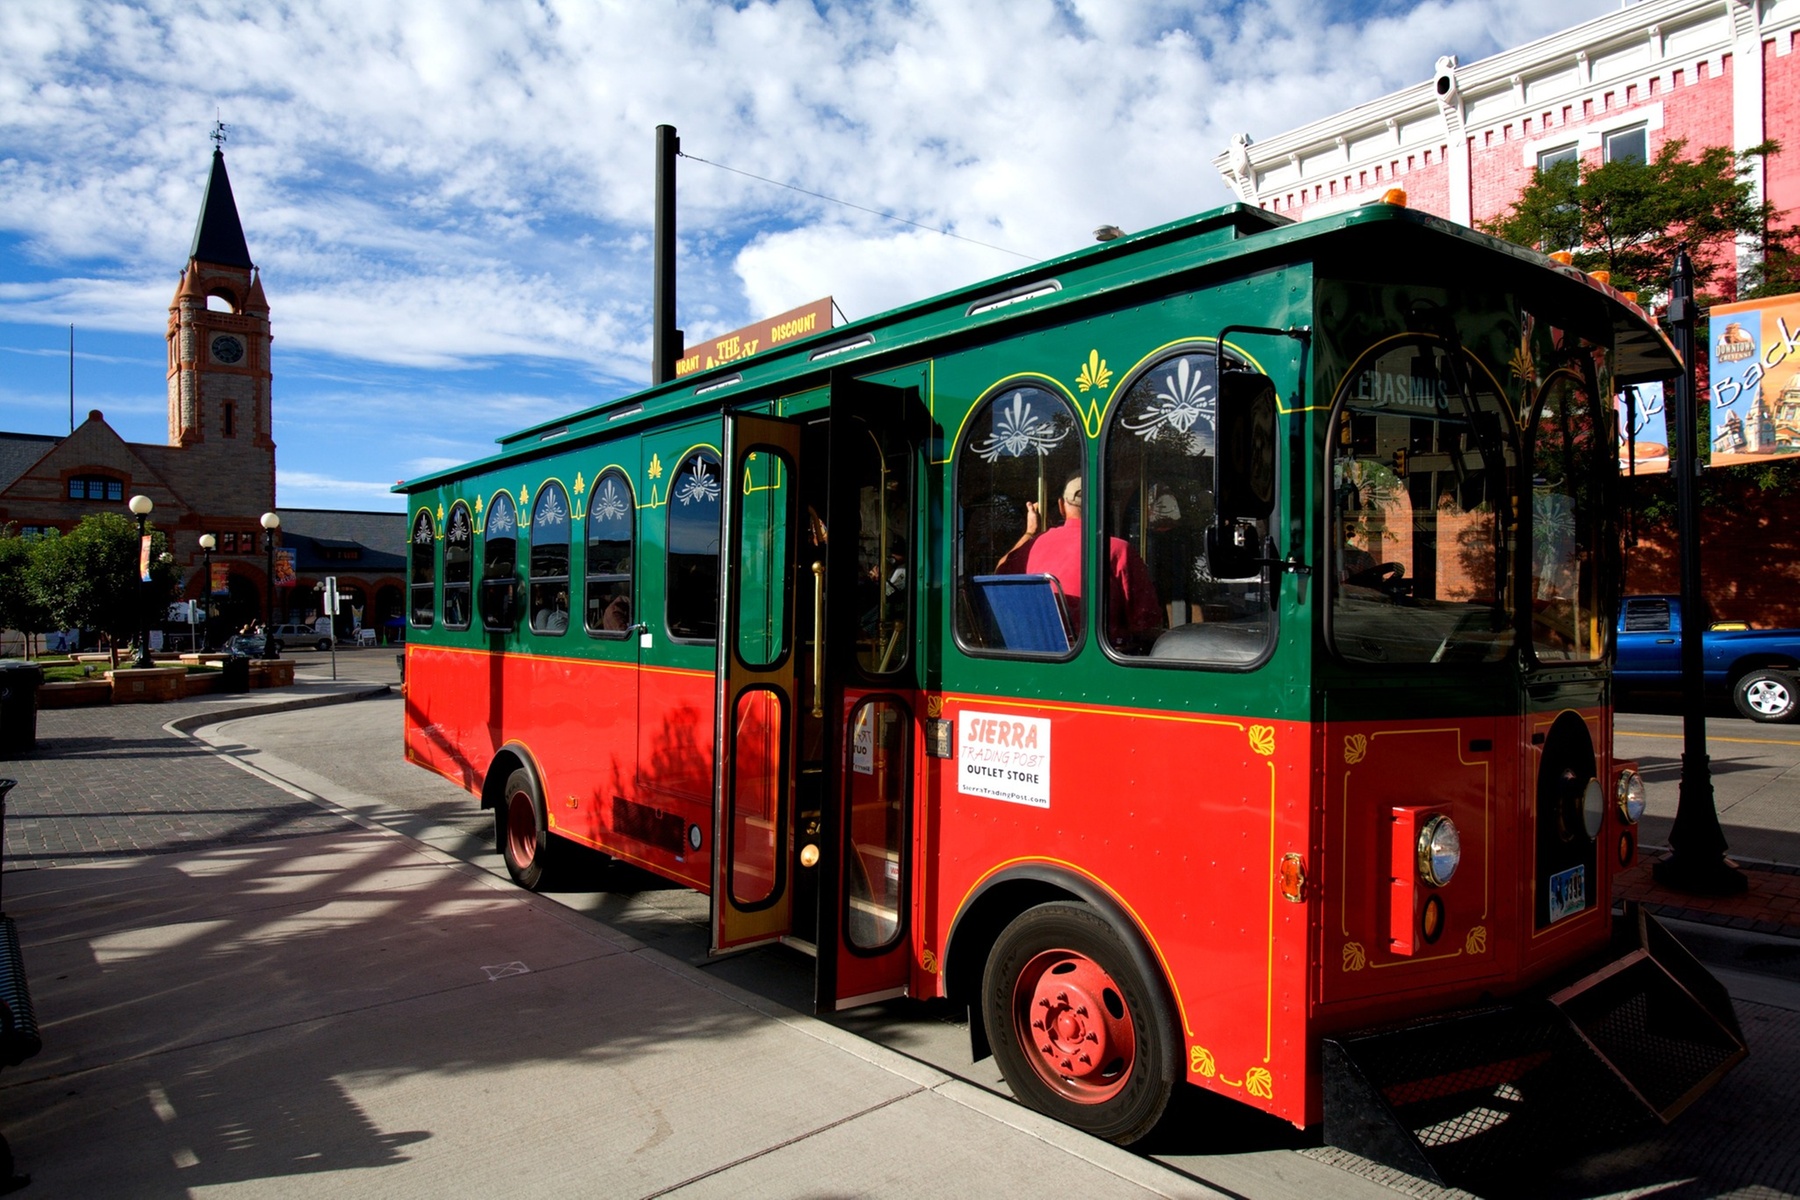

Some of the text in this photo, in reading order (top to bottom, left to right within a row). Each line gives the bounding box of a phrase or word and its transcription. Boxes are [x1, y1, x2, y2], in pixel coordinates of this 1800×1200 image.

[771, 312, 817, 343] DISCOUNT
[716, 335, 740, 360] THE
[1716, 341, 1756, 357] DOWNTOWN
[676, 354, 700, 375] URANT
[1711, 317, 1800, 409] Back
[1358, 369, 1449, 409] ERASMUS
[967, 718, 1038, 749] SIERRA
[961, 745, 1010, 767] TRADING
[1013, 752, 1045, 768] POST
[967, 764, 1039, 784] OUTLET STORE
[962, 784, 1047, 804] SierraTradingPost.com
